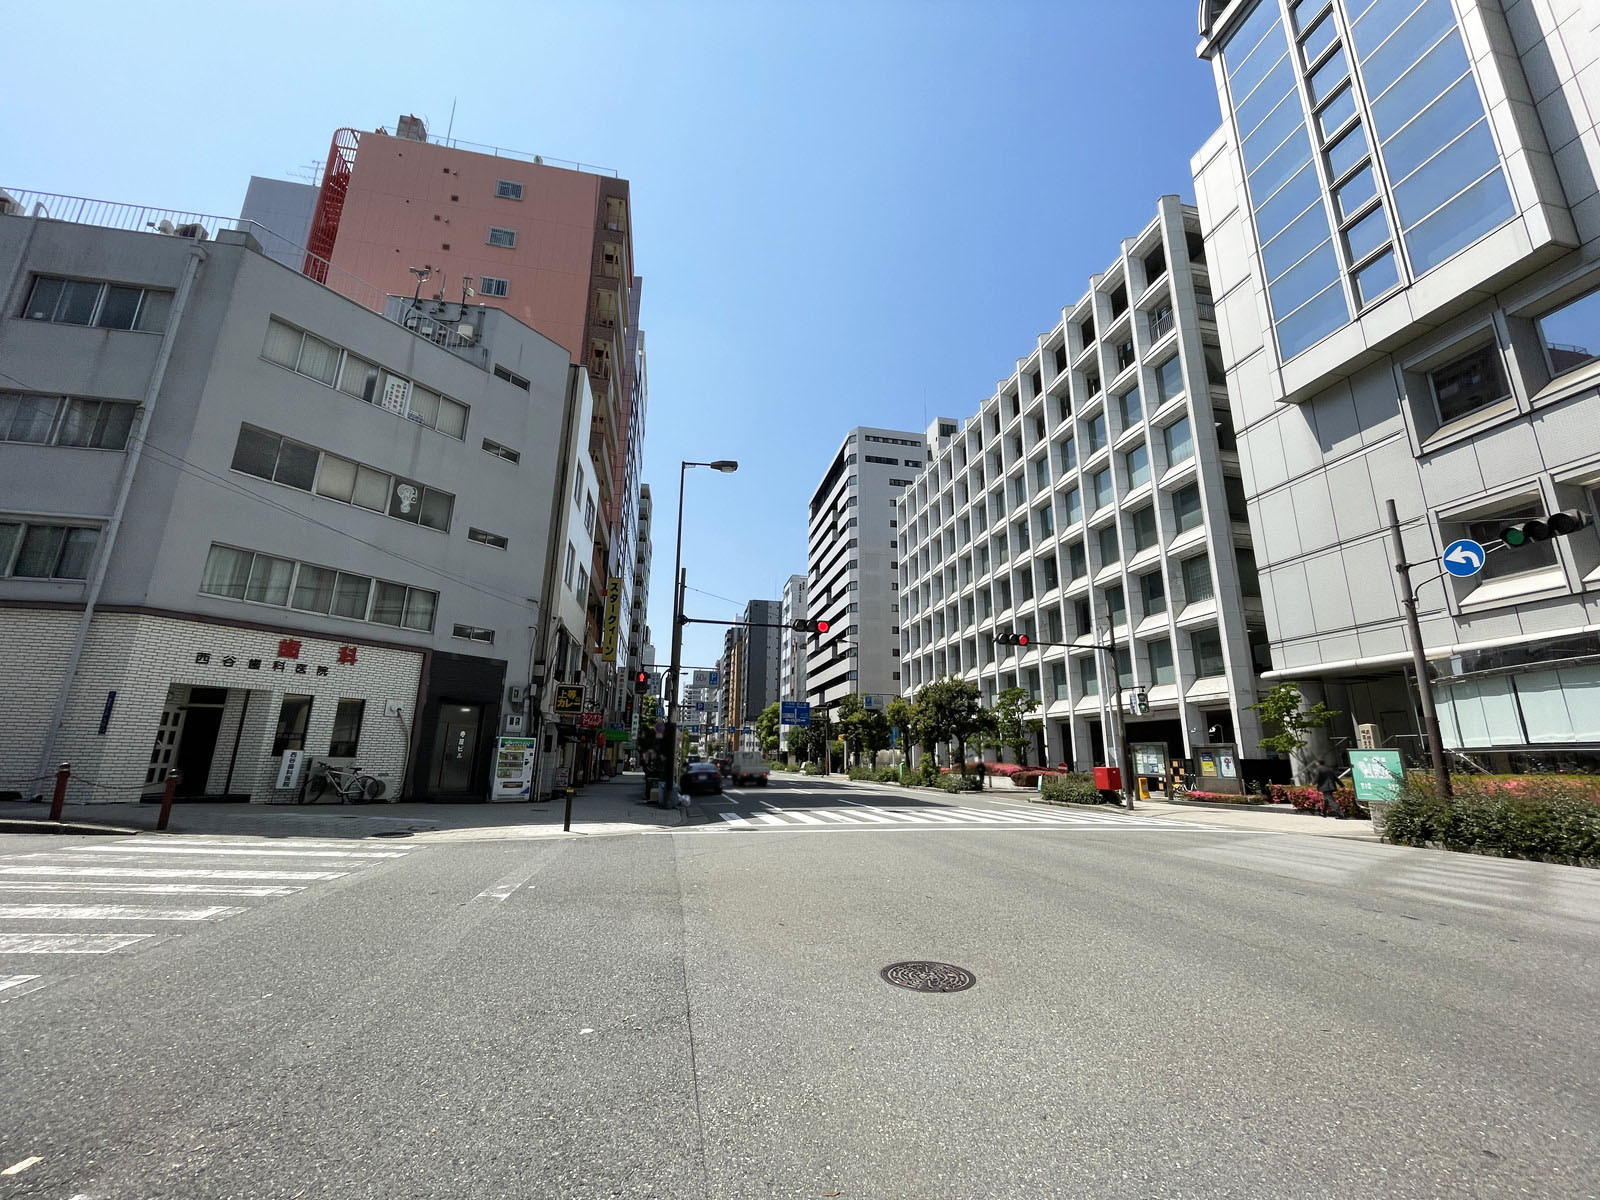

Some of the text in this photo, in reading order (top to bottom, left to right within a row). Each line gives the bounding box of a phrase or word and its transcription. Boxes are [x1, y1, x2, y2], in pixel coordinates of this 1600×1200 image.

[278, 638, 358, 665] 歯科
[195, 652, 329, 676] 西谷歯科医院
[557, 699, 581, 708] カレー
